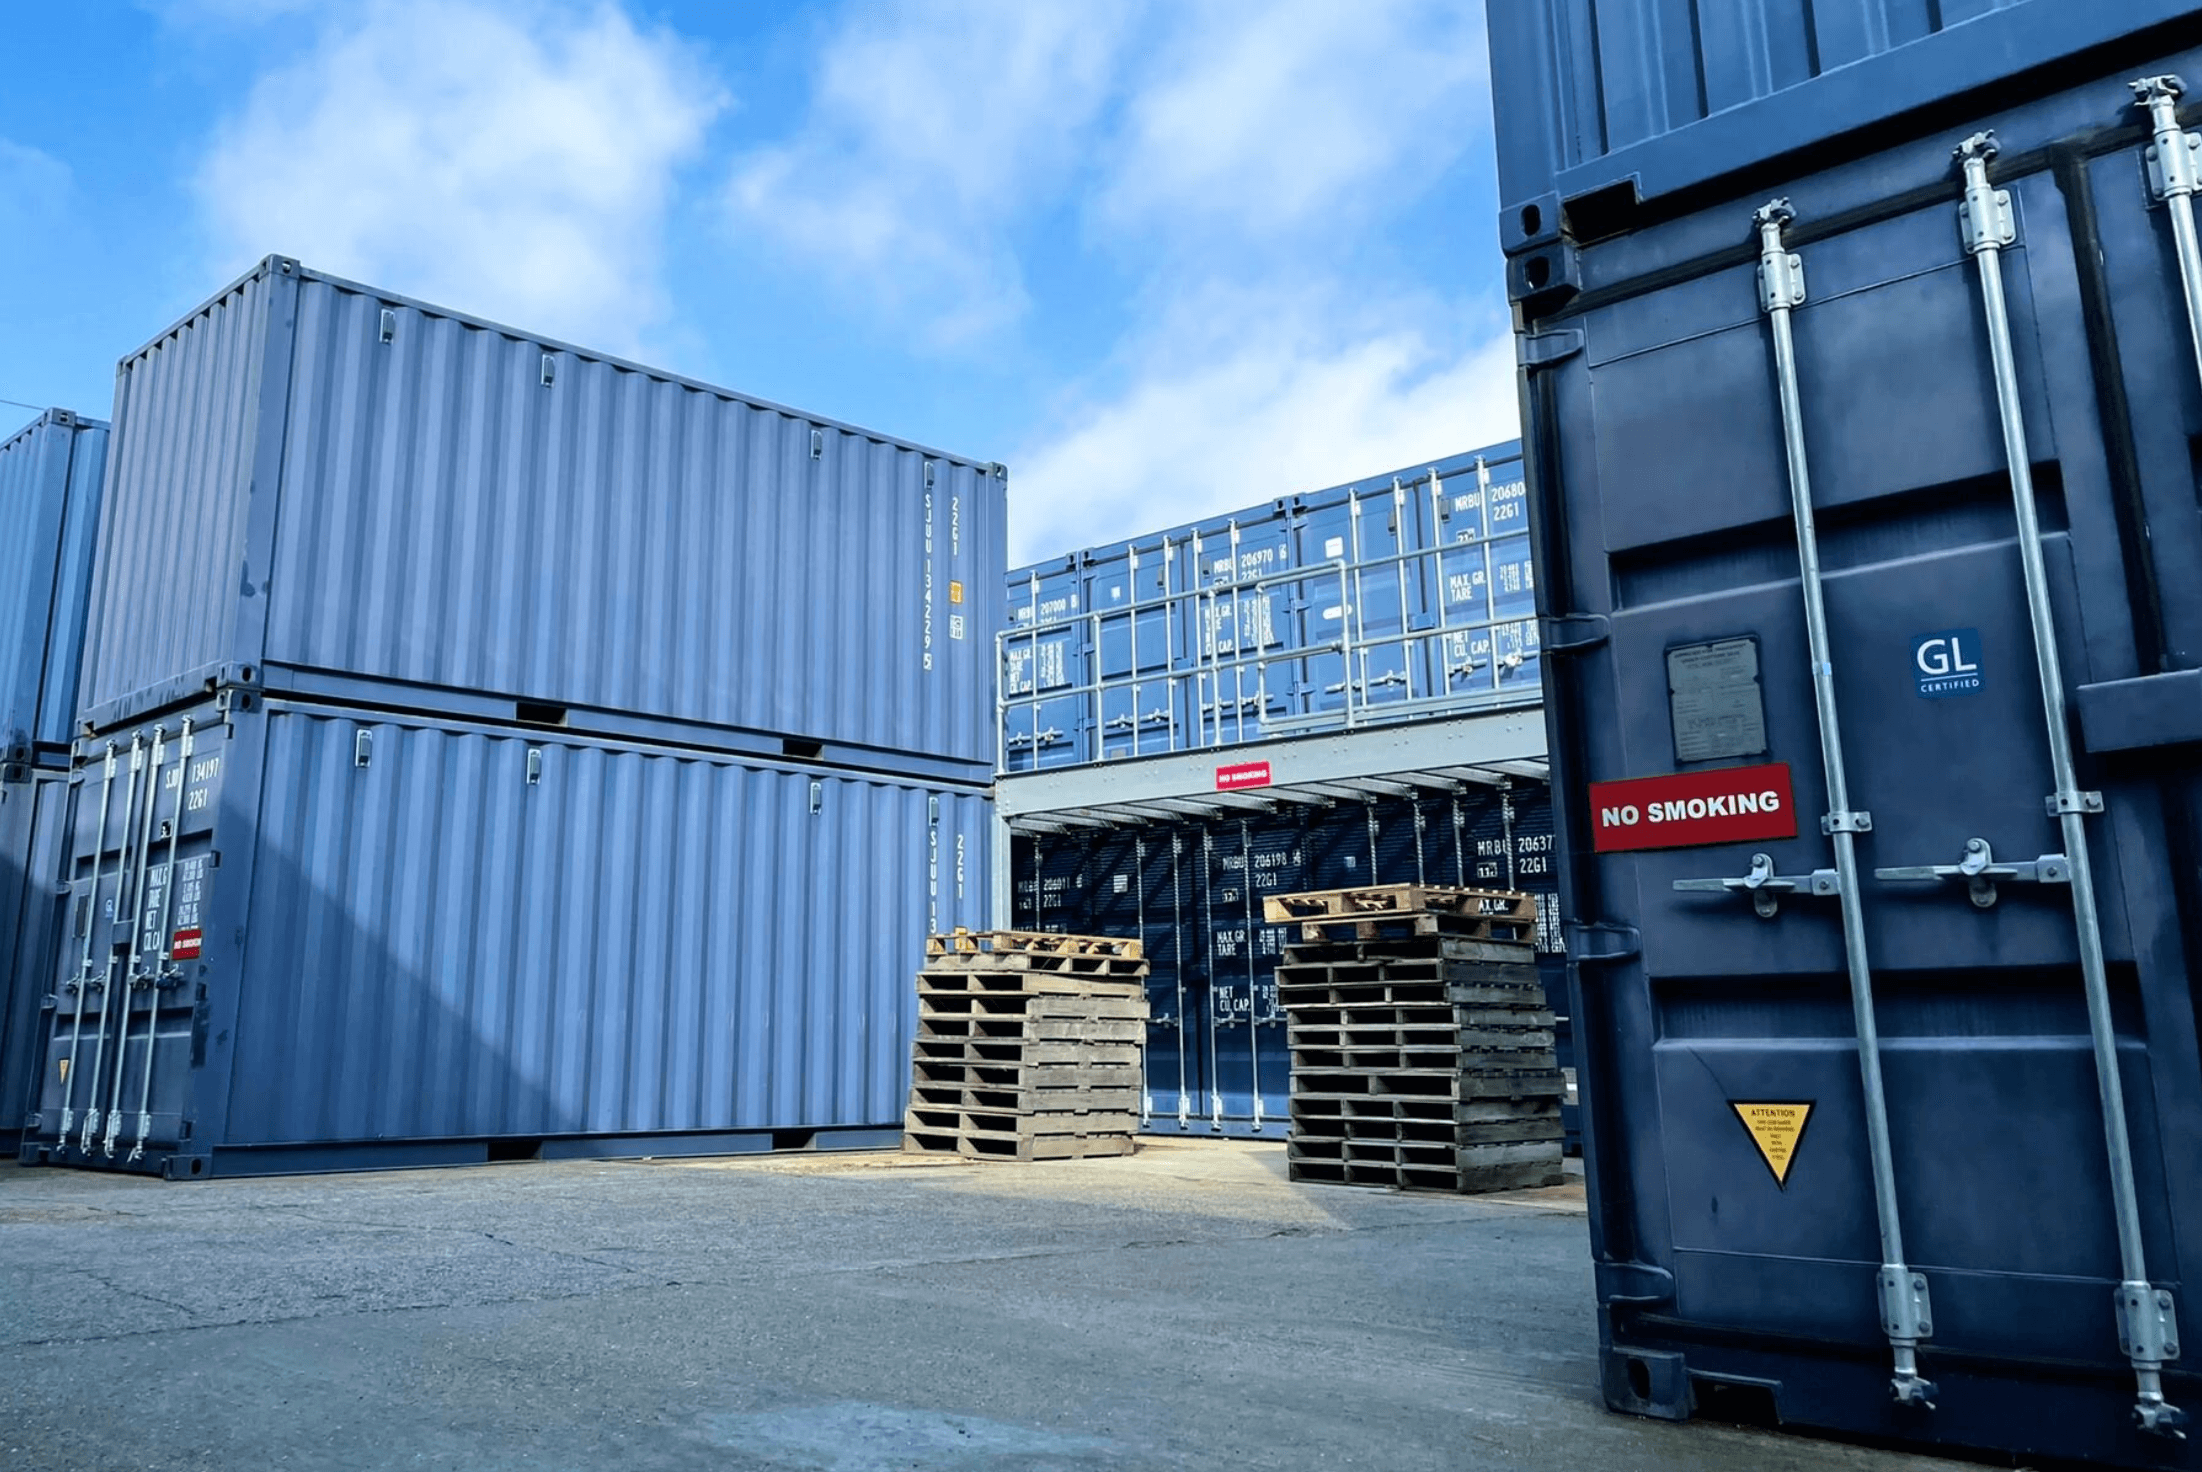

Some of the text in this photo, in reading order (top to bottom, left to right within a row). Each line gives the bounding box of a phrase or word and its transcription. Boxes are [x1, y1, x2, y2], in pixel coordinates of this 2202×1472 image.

[1455, 481, 1526, 512] MRBU 20680
[1493, 502, 1519, 521] 22G1
[1241, 548, 1273, 568] 206970
[924, 558, 932, 650] 134229
[1917, 637, 1977, 675] GL
[1920, 679, 1980, 693] CERTIFIED
[1601, 790, 1780, 827] NO SMOKING
[1254, 852, 1287, 869] 206198
[1520, 856, 1547, 873] 22G1
[1255, 872, 1278, 888] 22G1
